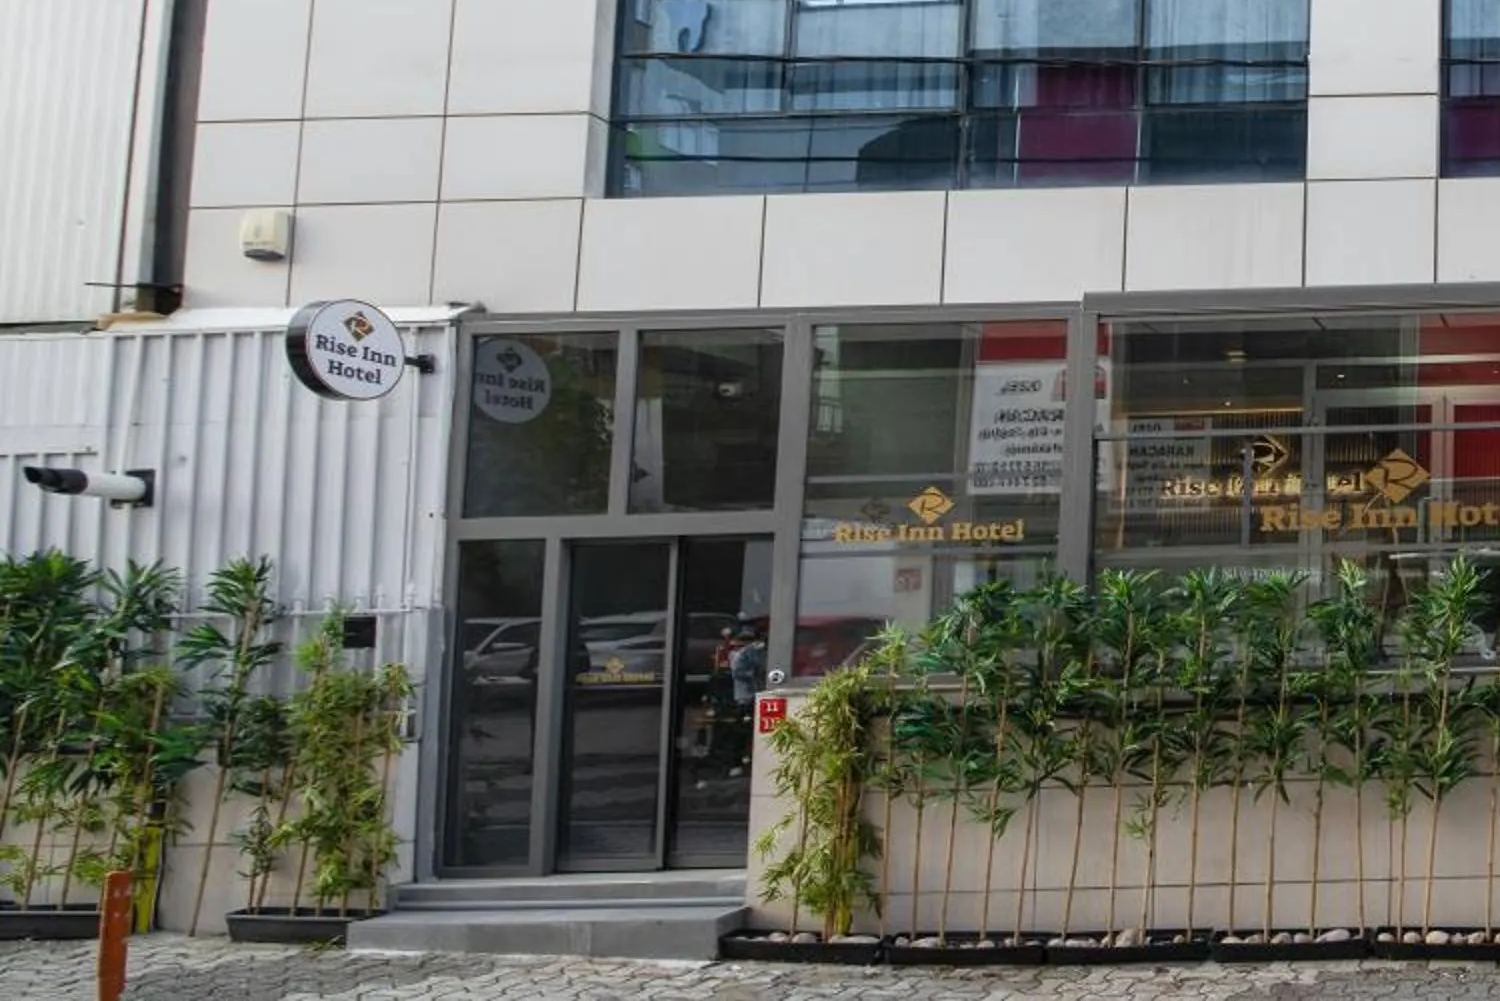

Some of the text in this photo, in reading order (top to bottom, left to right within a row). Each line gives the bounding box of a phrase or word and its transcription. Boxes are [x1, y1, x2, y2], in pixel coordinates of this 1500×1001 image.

[315, 334, 397, 367] Rise Inn
[327, 359, 382, 385] Hotel
[1259, 502, 1342, 531] Rise
[1348, 502, 1418, 528] Inn
[834, 518, 1025, 543] Rise Inn Hotel
